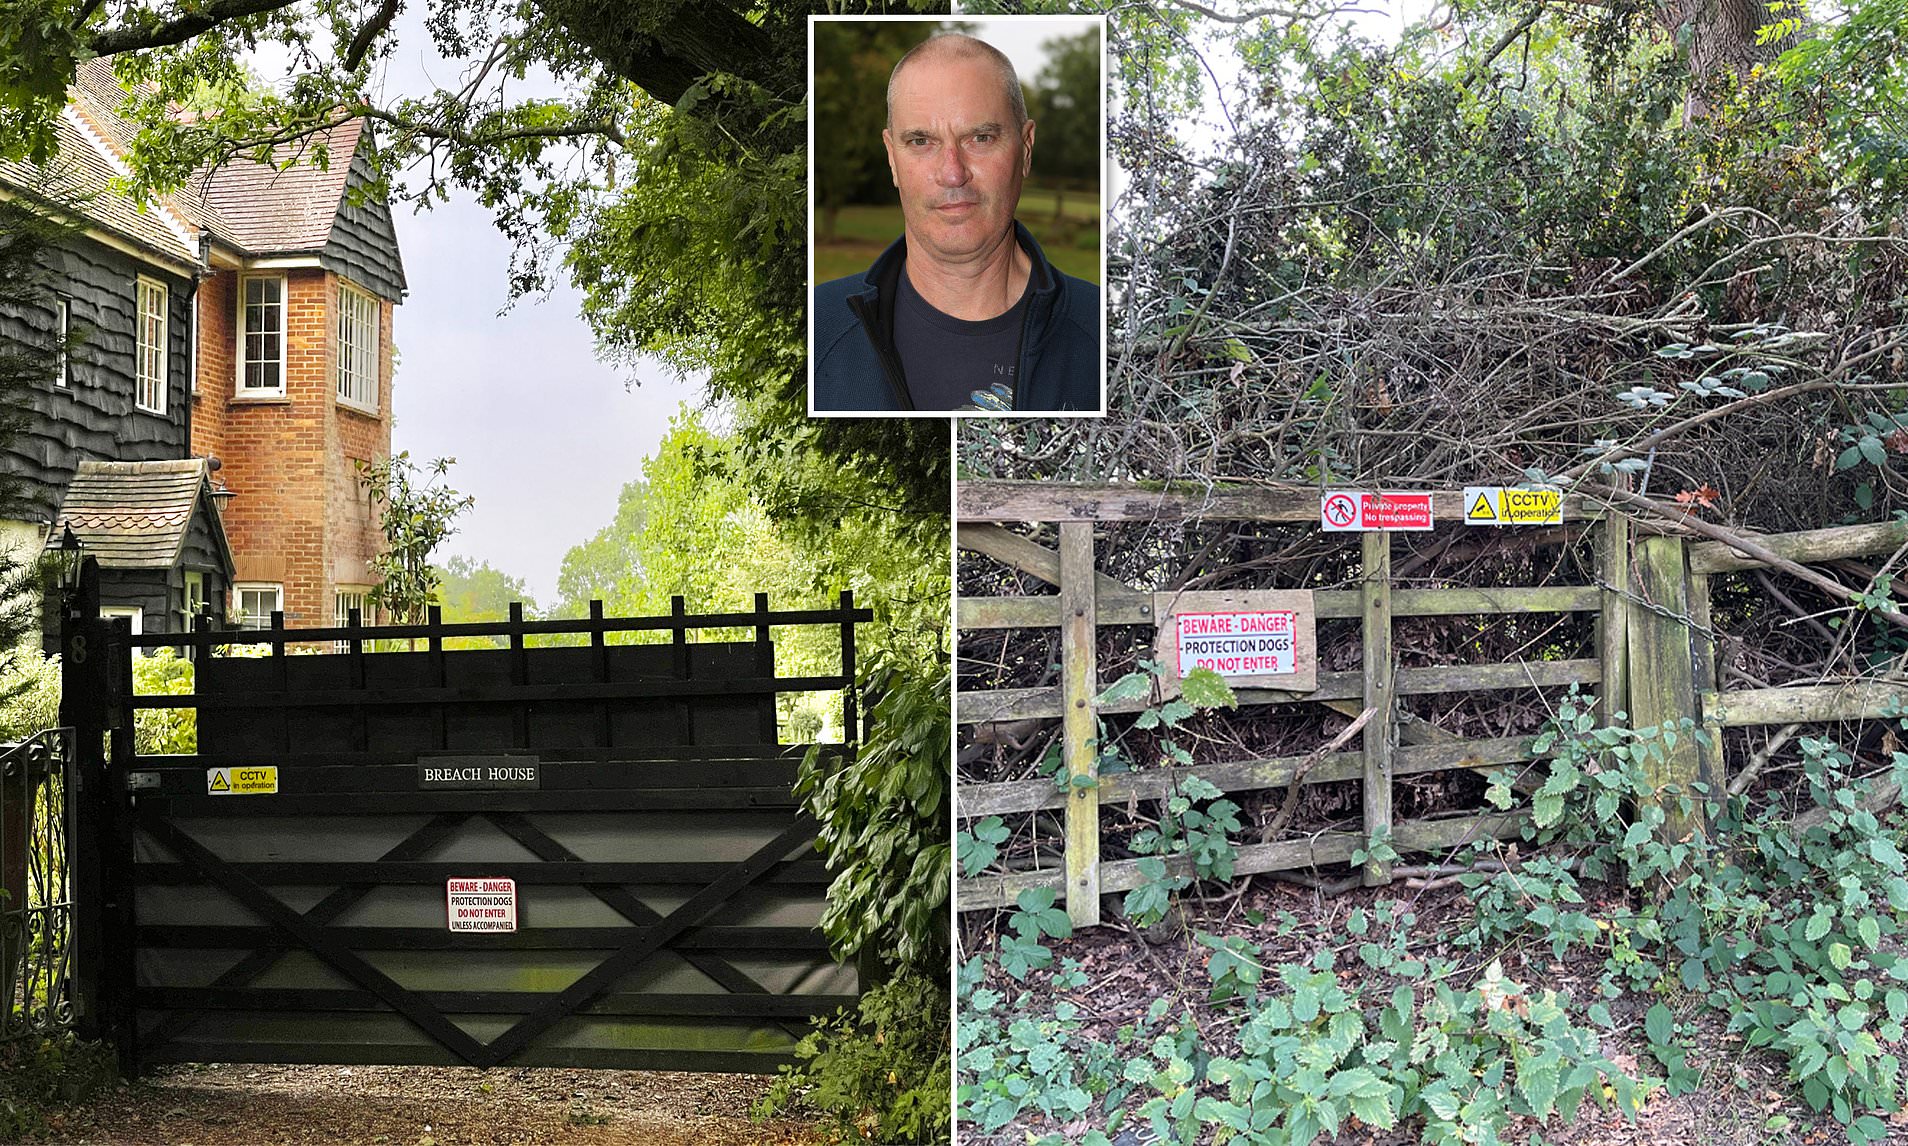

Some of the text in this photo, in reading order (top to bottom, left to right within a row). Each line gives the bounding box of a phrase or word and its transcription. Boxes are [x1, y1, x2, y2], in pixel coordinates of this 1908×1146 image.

[1512, 494, 1549, 506] CCTV
[1362, 502, 1428, 511] Private property
[1379, 513, 1427, 523] trespassing
[1183, 619, 1232, 634] BEWARE
[1241, 617, 1288, 632] DANGER
[71, 635, 87, 664] 8
[1185, 639, 1289, 654] PROTECTION DOGS
[1197, 656, 1278, 671] DO NOT ENTER
[240, 771, 267, 781] CCTV
[424, 767, 535, 781] BREACH HOUSE
[241, 782, 275, 791] operation
[450, 881, 479, 892] BEWARE
[483, 881, 512, 892] DANGER
[451, 897, 513, 906] PROTECTION DOGS
[458, 909, 506, 918] DO NOT ENTER
[451, 921, 473, 930] UNLESS
